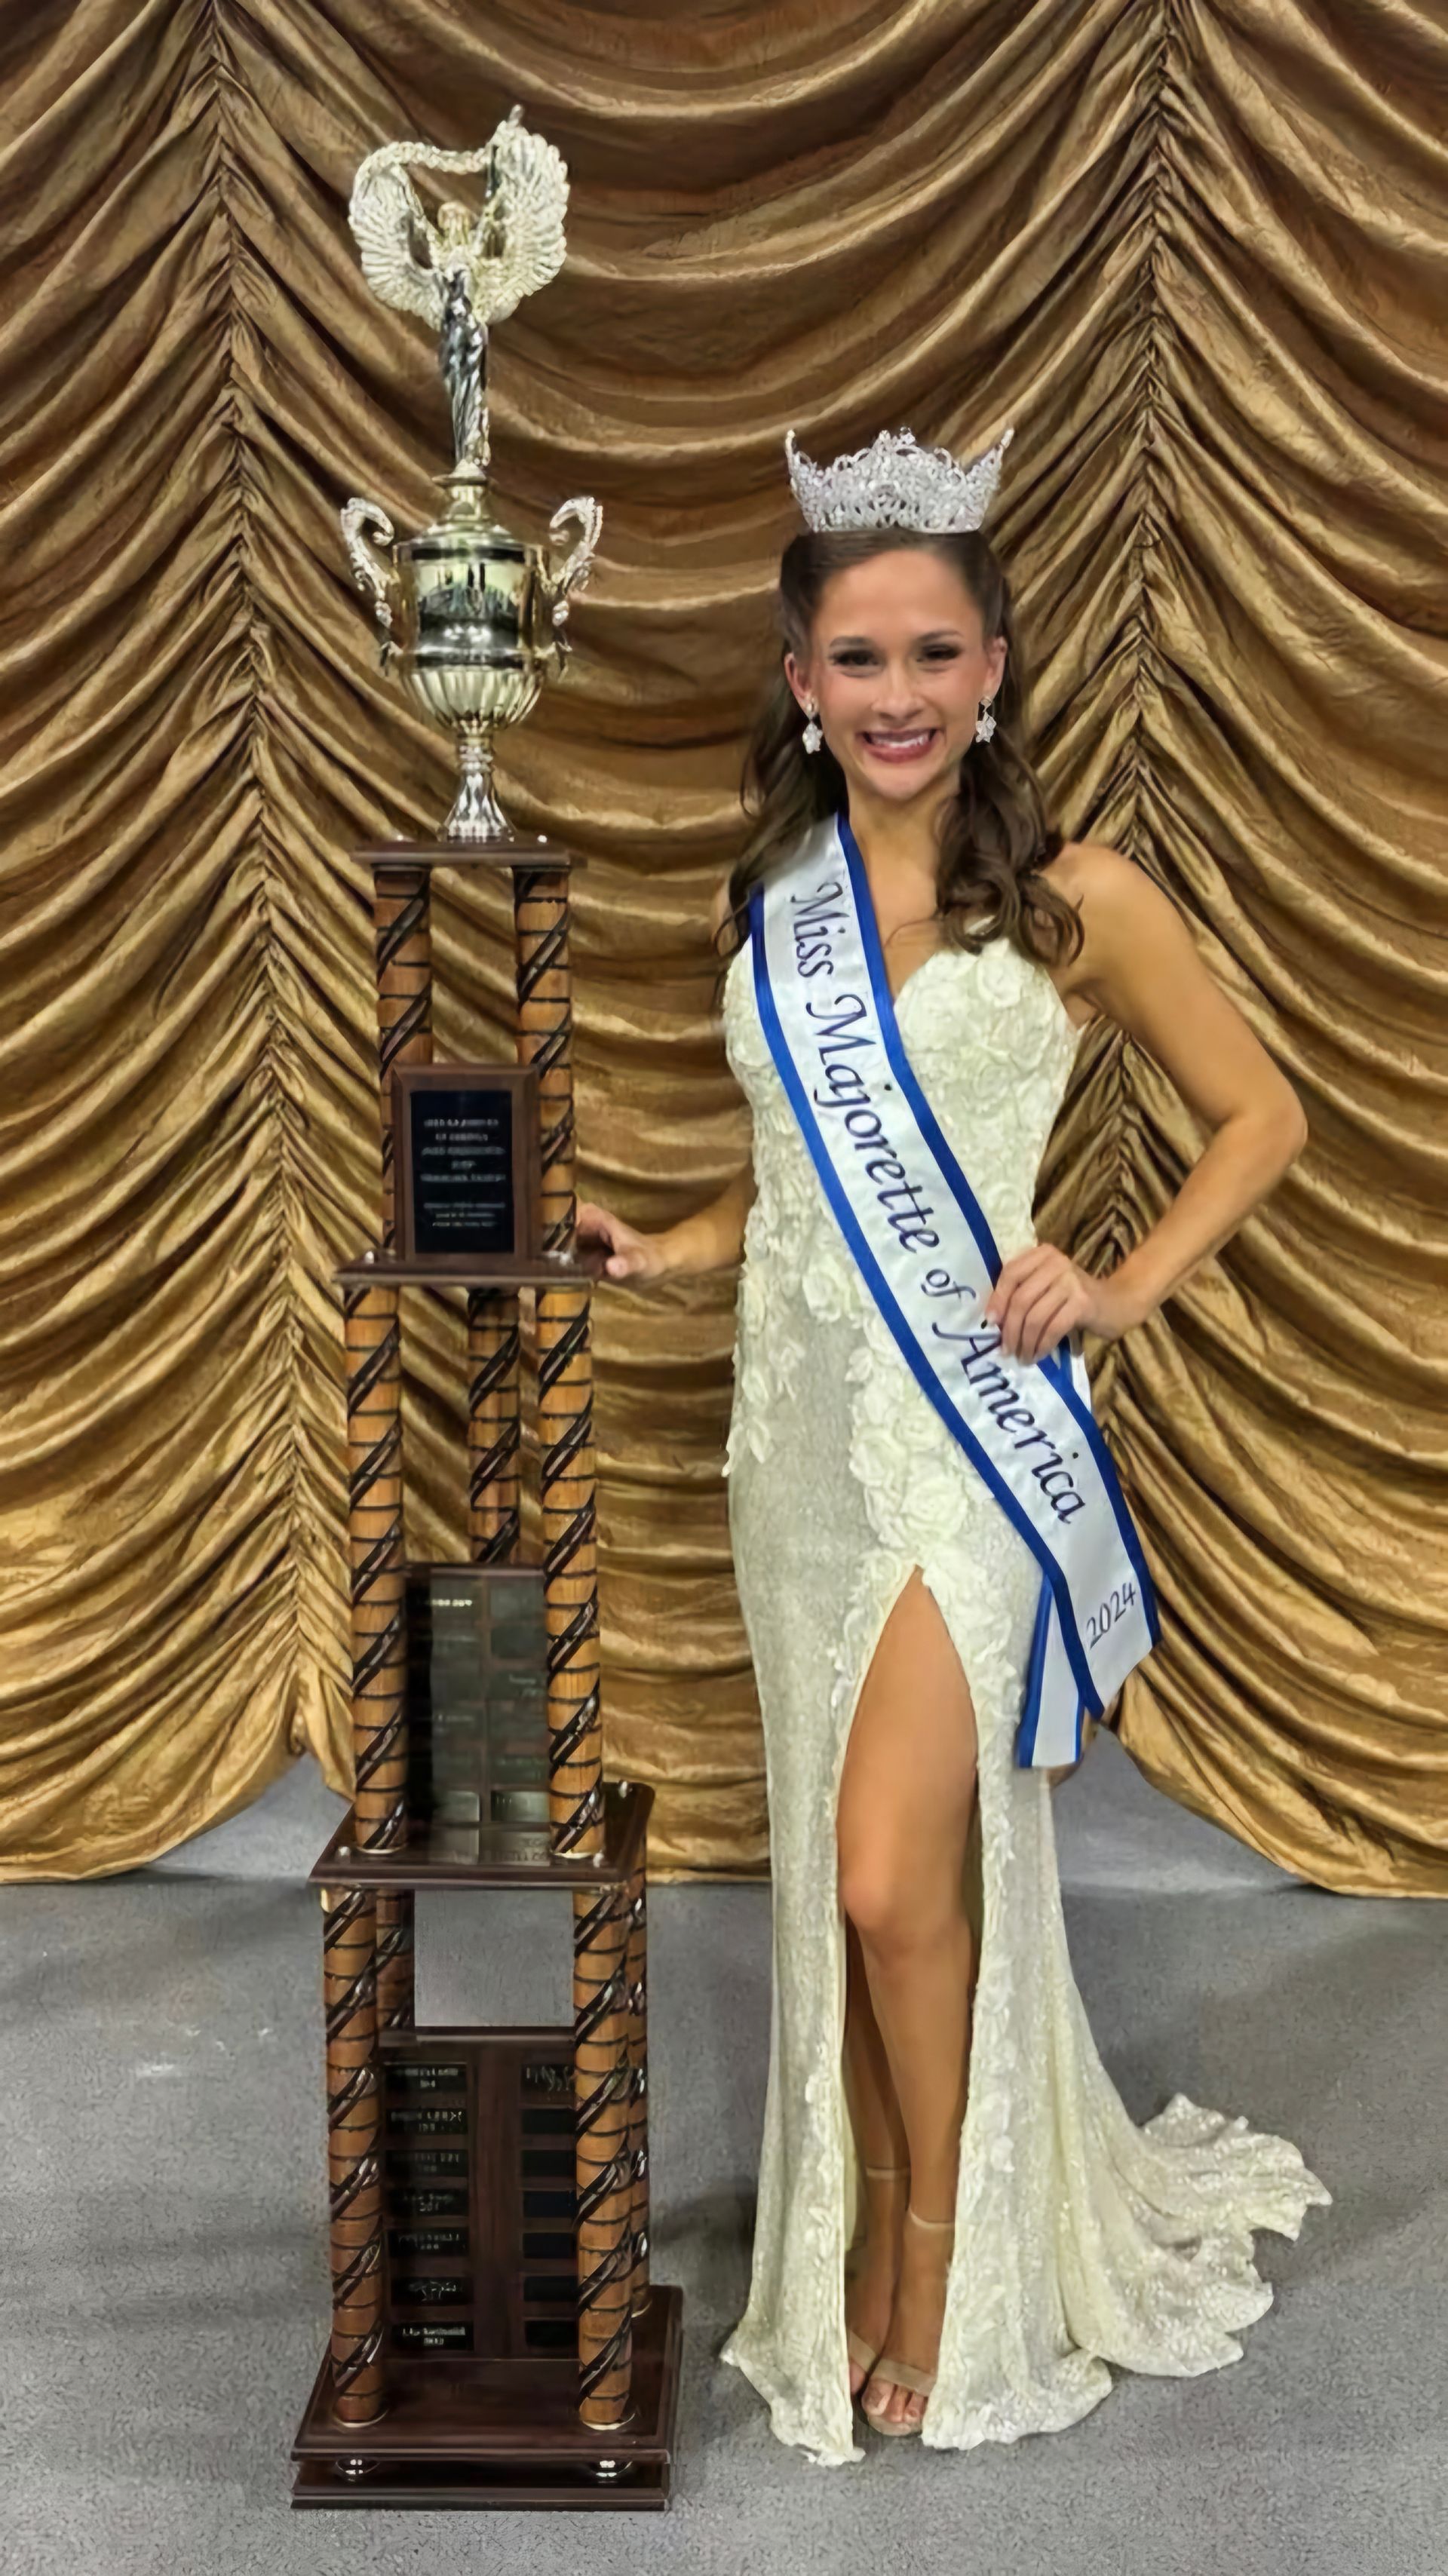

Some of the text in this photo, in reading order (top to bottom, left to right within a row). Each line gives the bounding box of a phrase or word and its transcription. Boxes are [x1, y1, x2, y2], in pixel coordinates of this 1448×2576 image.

[791, 882, 1086, 1524] Miss Majorette of America
[1086, 1581, 1137, 1648] 2024
